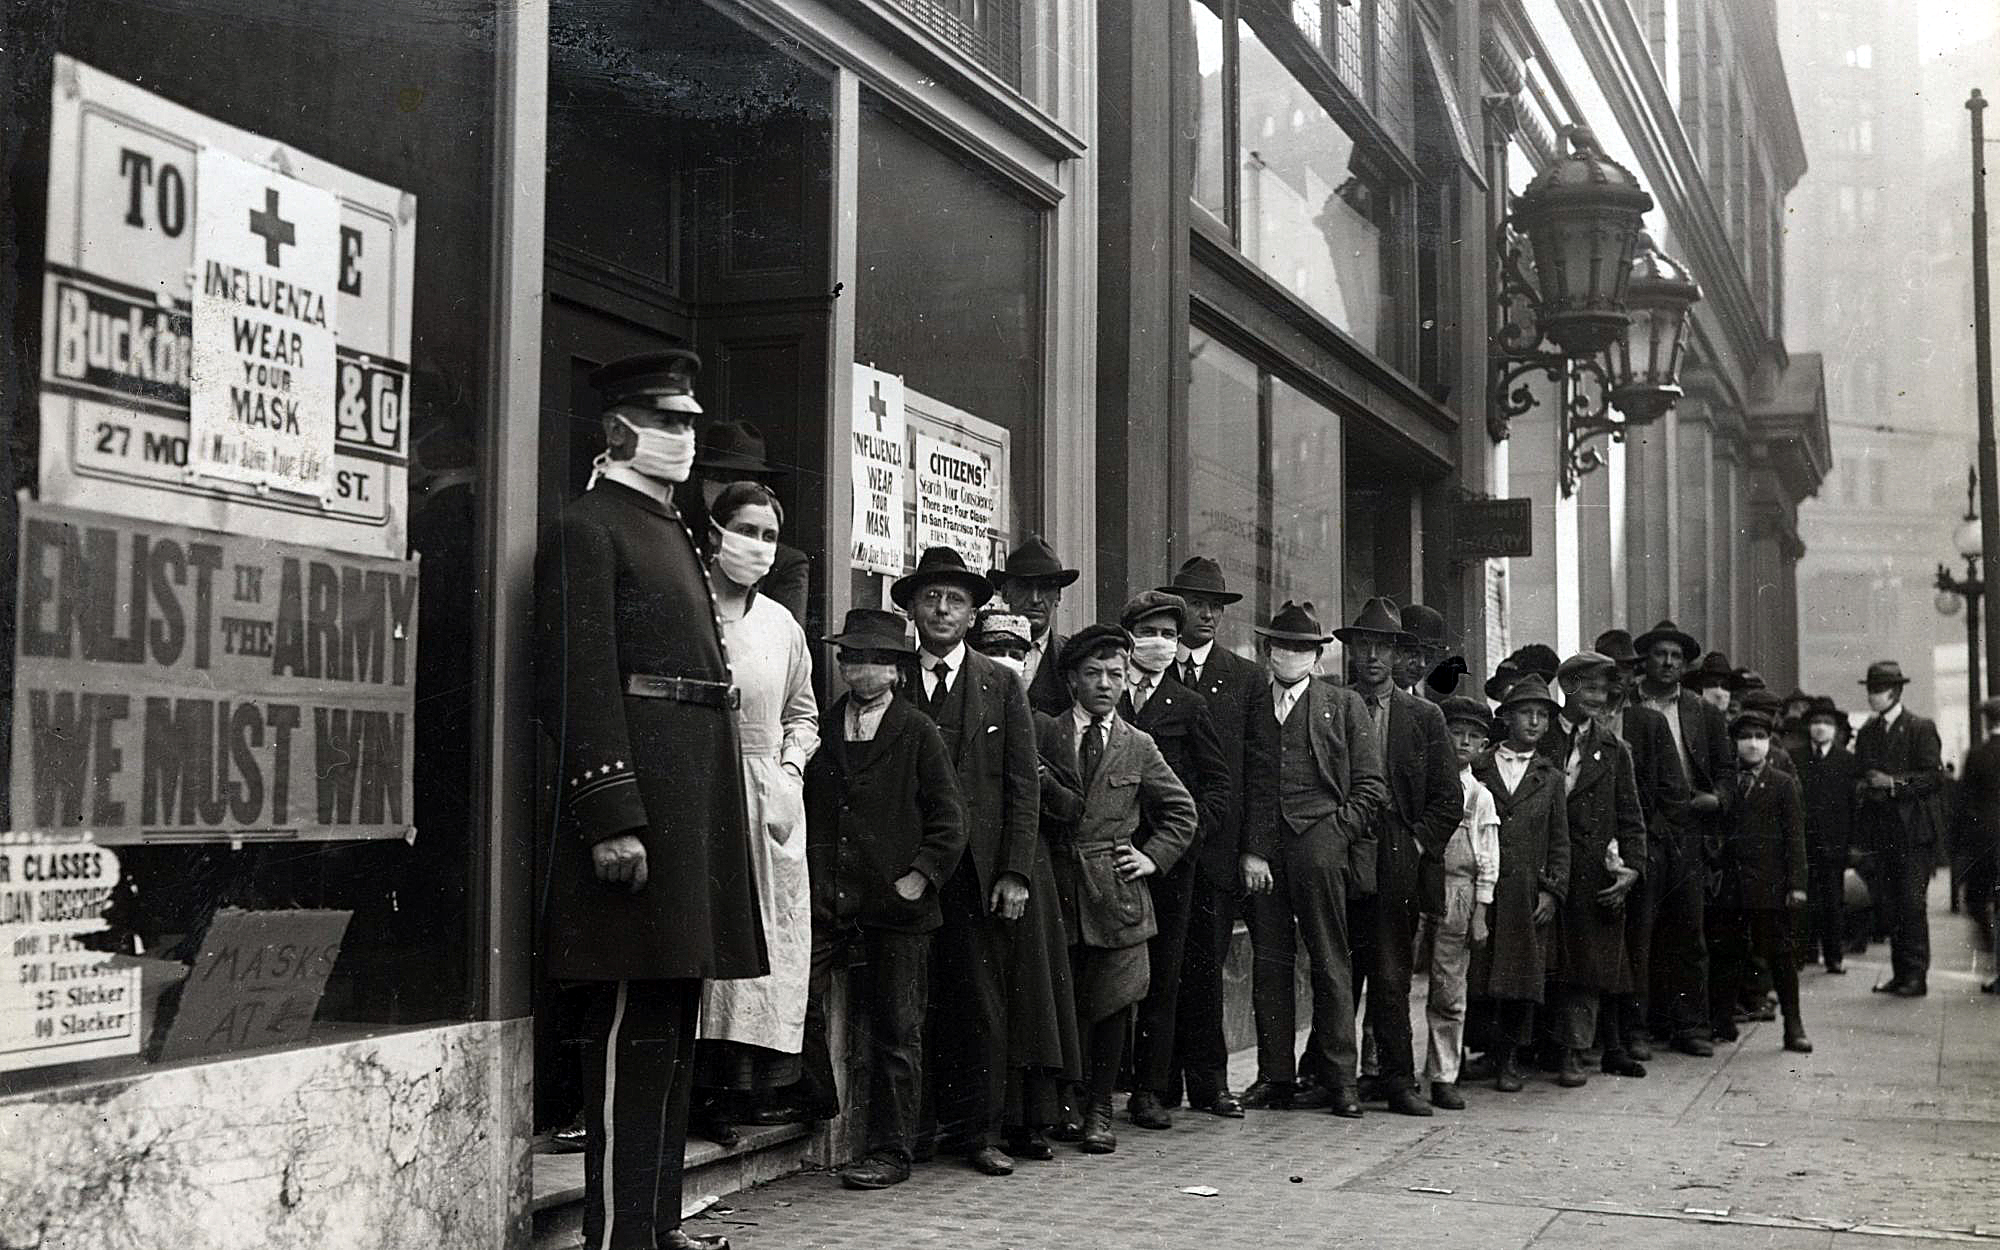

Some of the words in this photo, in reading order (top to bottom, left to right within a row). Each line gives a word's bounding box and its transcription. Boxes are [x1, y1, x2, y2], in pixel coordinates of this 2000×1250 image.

[120, 148, 186, 238] TO
[205, 260, 326, 329] INFLUENZA
[232, 316, 304, 368] WEAR
[243, 360, 292, 393] YOUR
[231, 386, 300, 436] MASK
[97, 421, 131, 456] 27
[337, 469, 369, 502] ST.
[853, 431, 902, 468] INFLUENZA
[867, 465, 893, 495] WEAR
[919, 475, 942, 497] Search
[929, 453, 987, 489] CITIZENS!
[872, 493, 888, 513] YOUR
[922, 496, 940, 512] There
[942, 503, 953, 515] are
[954, 505, 968, 519] Four
[866, 510, 891, 539] MASK
[929, 513, 942, 528] San
[943, 517, 974, 535] Francisco
[23, 519, 223, 670] ENLIST
[234, 564, 263, 602] IN
[222, 617, 273, 657] THE
[272, 557, 418, 686] ARMY
[28, 688, 131, 826] WE
[142, 697, 301, 826] MUST
[314, 707, 405, 825] WIN
[24, 852, 102, 881] CLASSES
[202, 943, 341, 982] MASKS
[66, 985, 125, 1008] Slicker
[59, 1012, 125, 1036] Slacker
